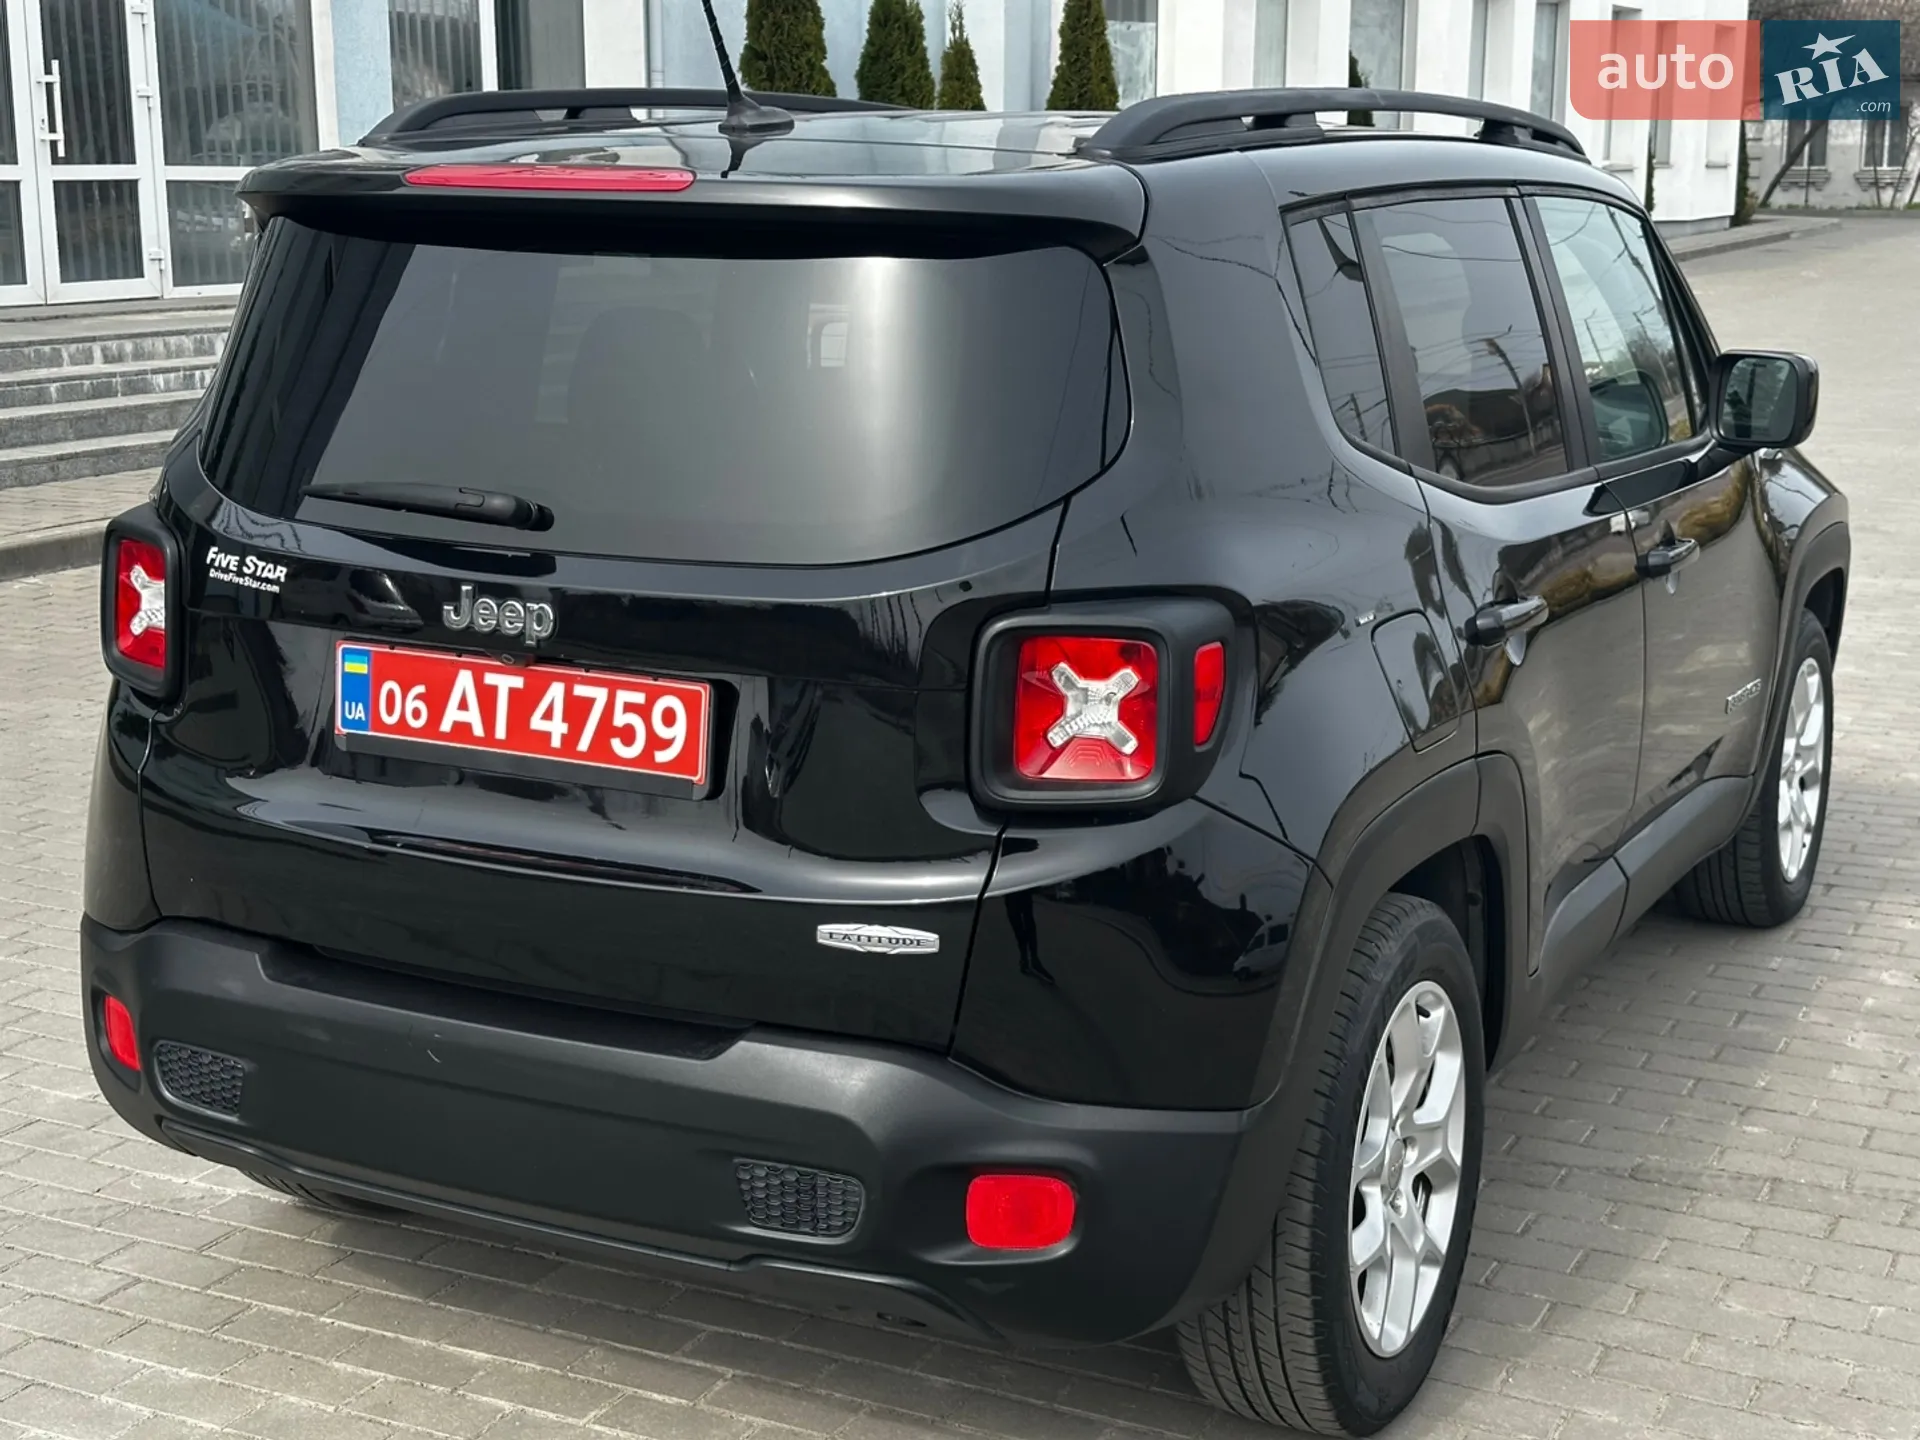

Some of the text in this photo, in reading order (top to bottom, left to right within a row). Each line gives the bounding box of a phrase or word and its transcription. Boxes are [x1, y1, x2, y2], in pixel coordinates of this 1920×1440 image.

[205, 546, 288, 583] FIVE STAR
[208, 567, 281, 594] DriveFiveStar.com
[442, 584, 555, 646] Jeep
[344, 700, 366, 722] UA
[378, 669, 688, 764] 06 AT 4759
[828, 931, 928, 948] LATITUDE
